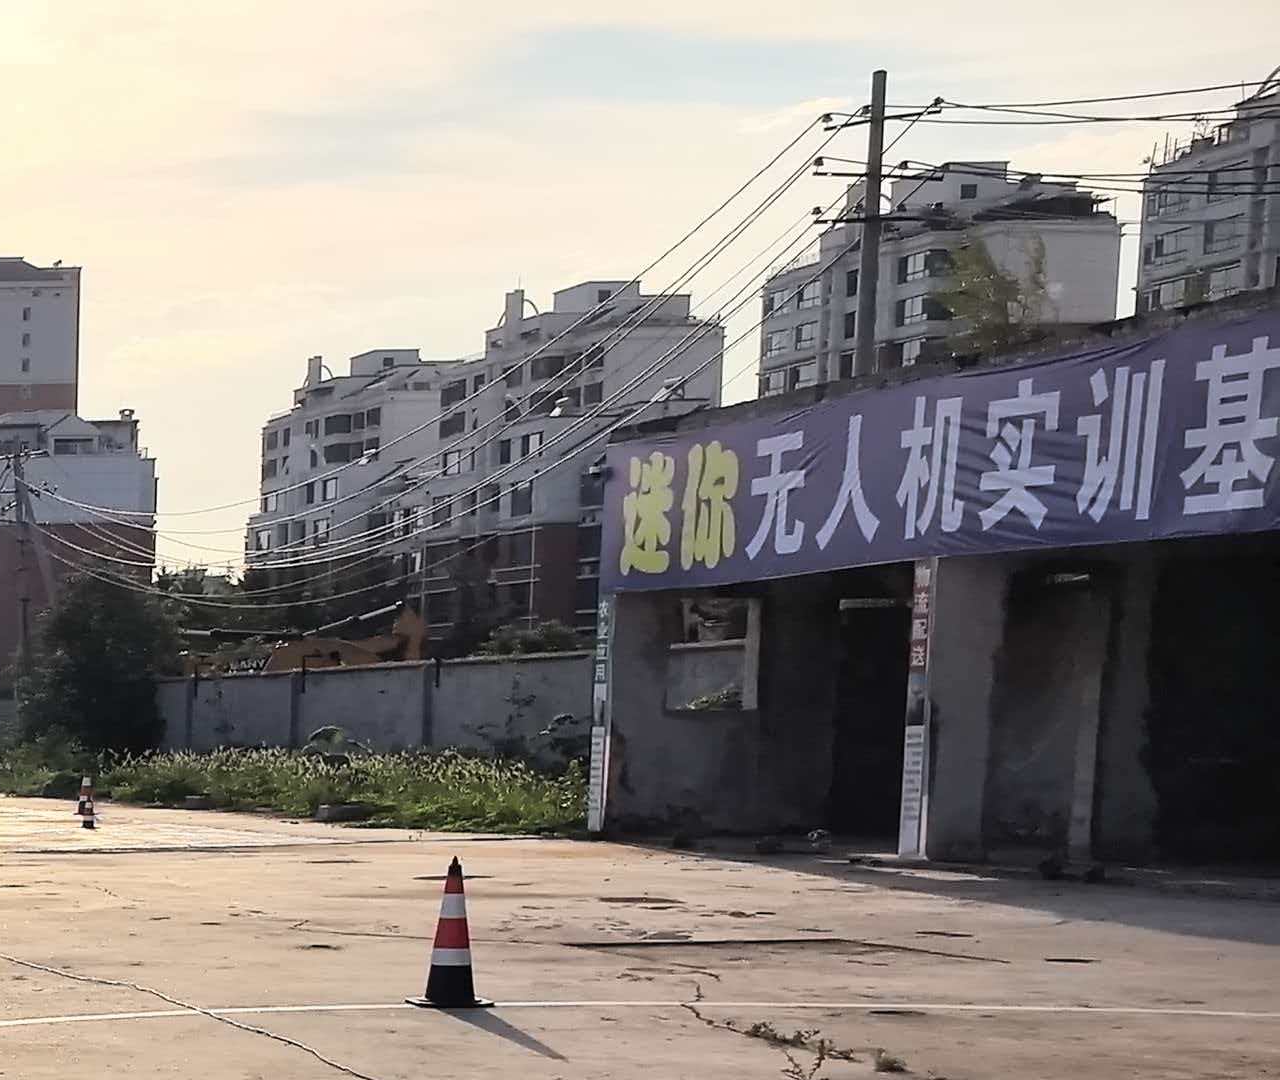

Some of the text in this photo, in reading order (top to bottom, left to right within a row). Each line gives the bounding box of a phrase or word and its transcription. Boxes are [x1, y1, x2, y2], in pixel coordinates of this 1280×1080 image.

[620, 336, 1280, 576] 迷你无人机实训基
